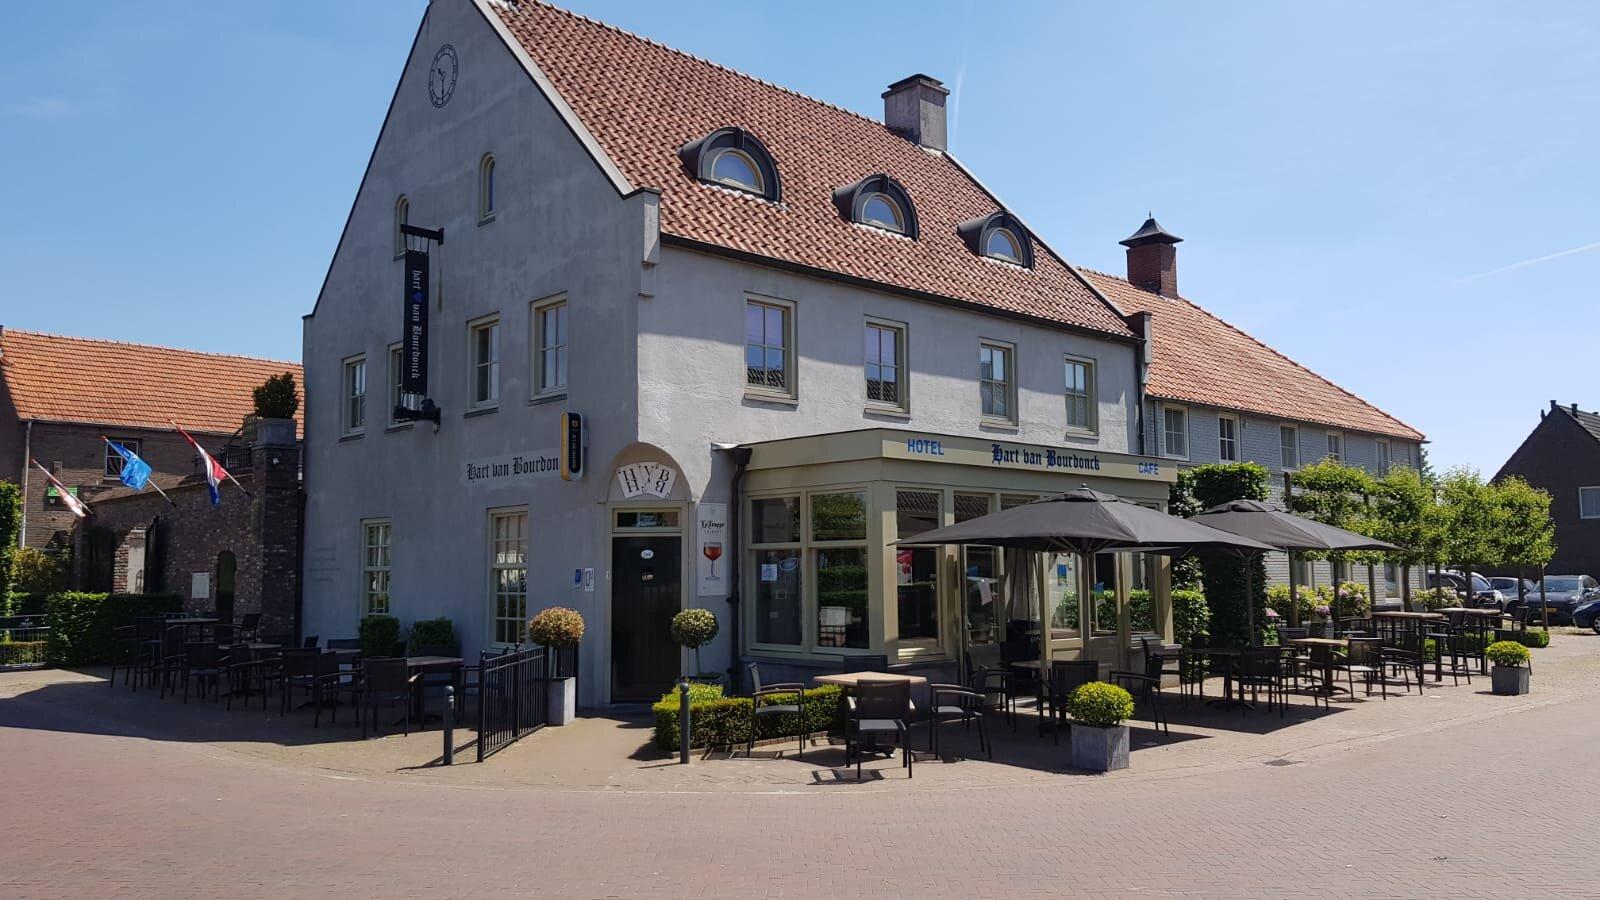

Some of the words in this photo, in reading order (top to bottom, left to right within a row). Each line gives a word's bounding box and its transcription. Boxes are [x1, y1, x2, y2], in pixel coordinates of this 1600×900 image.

[412, 304, 420, 322] van
[411, 325, 422, 379] Bourdonck
[907, 438, 944, 456] HOTEL
[991, 443, 1019, 465] Hart
[1023, 448, 1042, 465] van
[1046, 449, 1100, 471] Bourdonck
[467, 462, 490, 482] Hart
[492, 462, 509, 478] van
[513, 456, 559, 475] Bourdon
